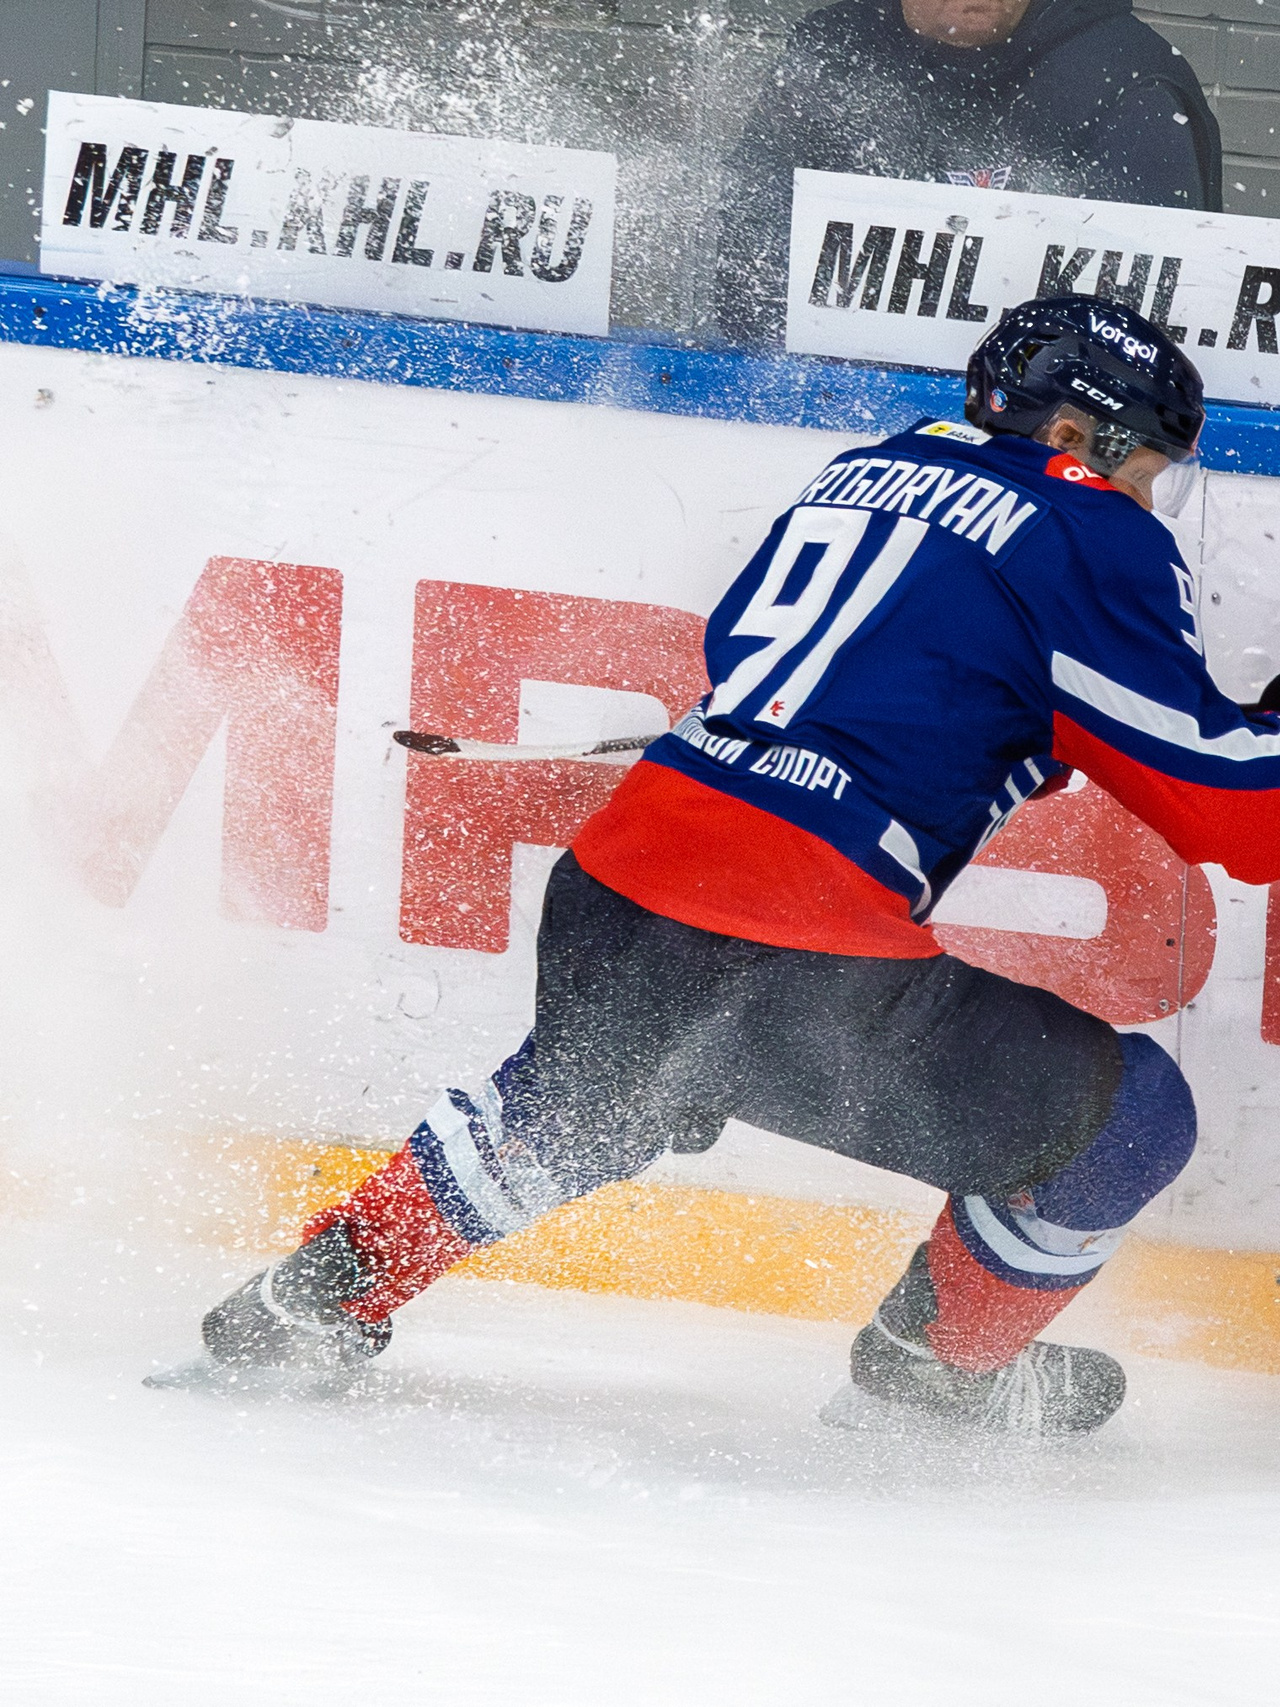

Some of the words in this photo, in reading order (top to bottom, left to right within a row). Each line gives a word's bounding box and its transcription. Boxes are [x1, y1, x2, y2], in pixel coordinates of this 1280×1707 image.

[1089, 314, 1159, 364] Vorgol
[1070, 377, 1124, 411] CCM
[798, 458, 1038, 555] RIGORYAN
[704, 506, 930, 728] 91
[749, 744, 852, 800] СПОРТ
